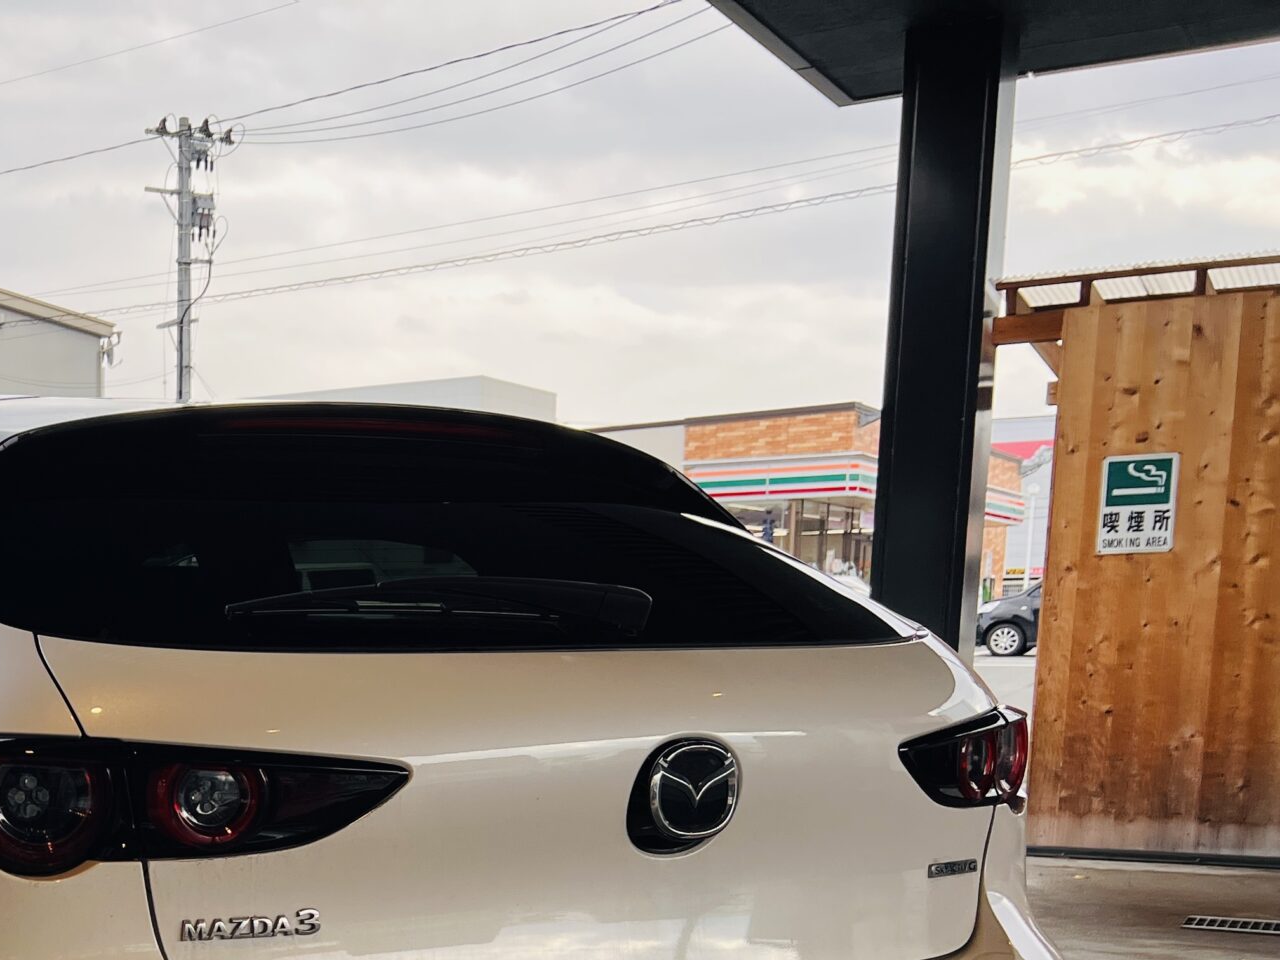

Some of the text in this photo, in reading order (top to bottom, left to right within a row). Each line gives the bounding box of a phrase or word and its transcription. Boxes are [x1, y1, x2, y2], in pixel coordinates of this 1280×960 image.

[1102, 509, 1171, 534] 喫煙所
[1102, 536, 1168, 549] SMOKING AREA
[180, 908, 322, 941] MAZDA3
